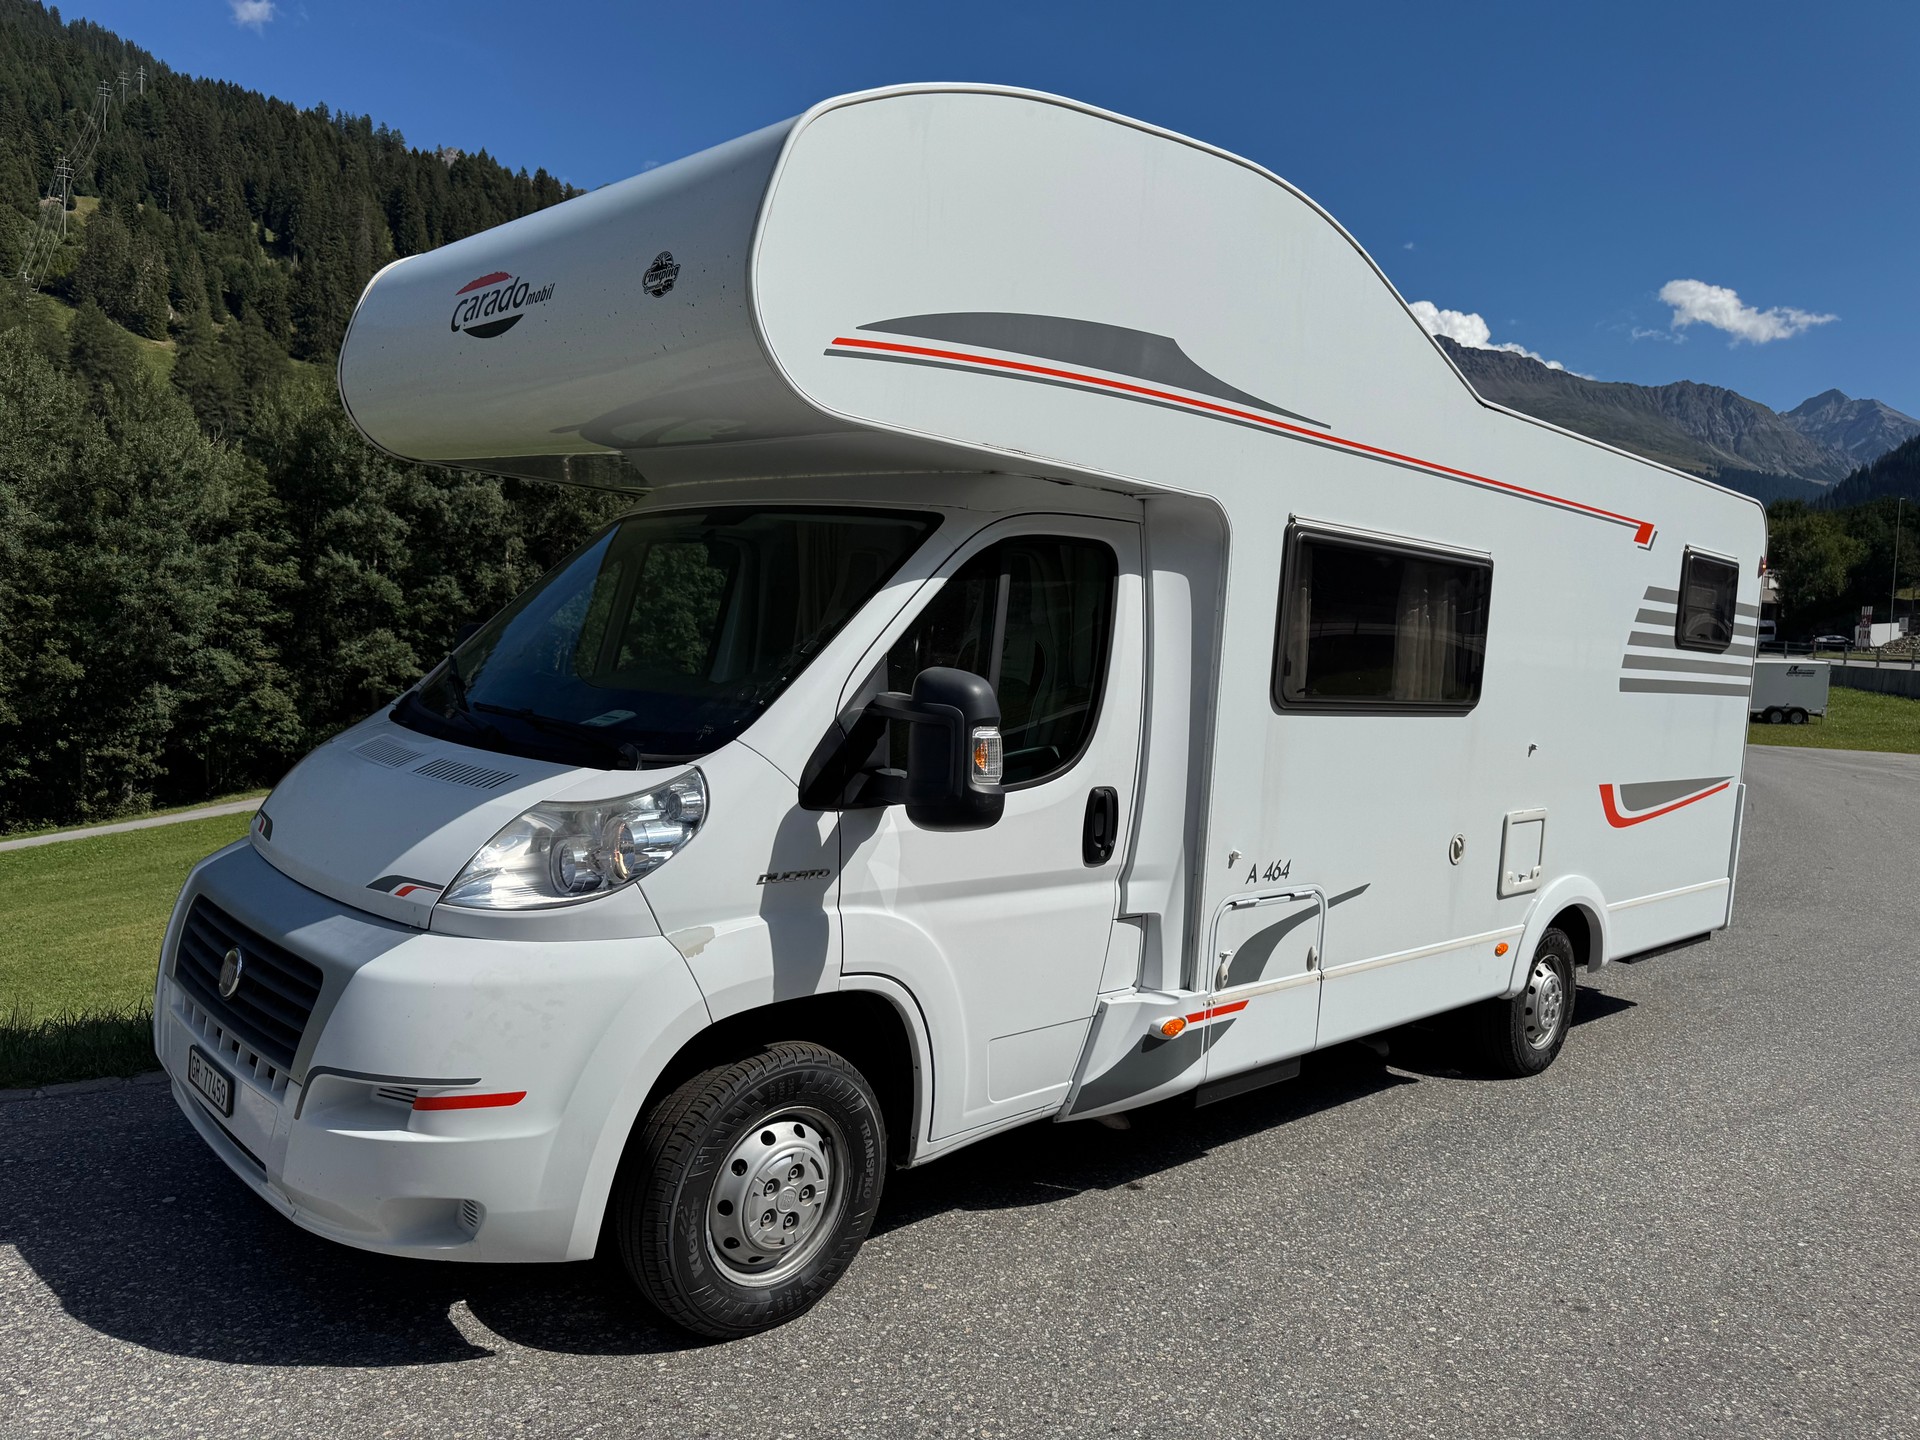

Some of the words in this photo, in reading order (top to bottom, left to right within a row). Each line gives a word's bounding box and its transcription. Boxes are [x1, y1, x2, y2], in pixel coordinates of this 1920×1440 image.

[756, 868, 831, 886] DUCATO
[1245, 863, 1257, 884] A
[1262, 859, 1292, 882] 464
[859, 1119, 875, 1199] TRANSPRO
[687, 1197, 705, 1279] Kleber
